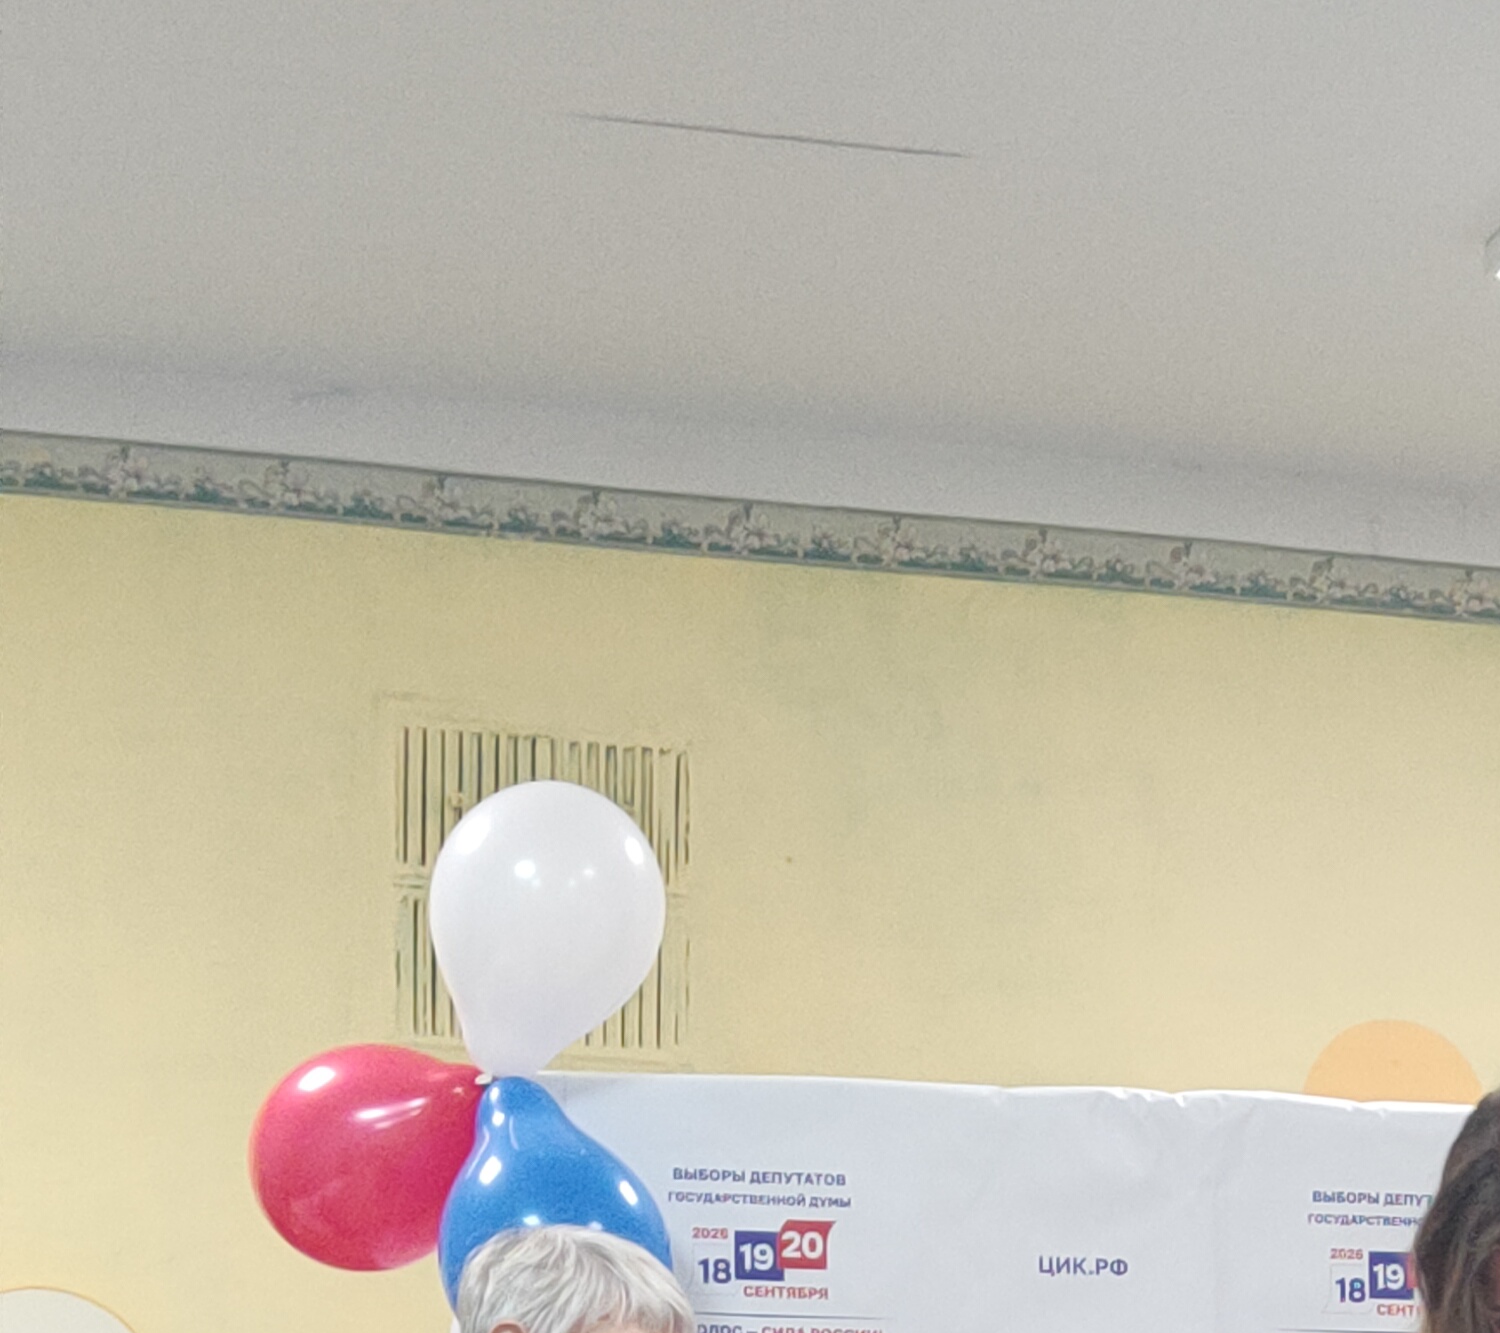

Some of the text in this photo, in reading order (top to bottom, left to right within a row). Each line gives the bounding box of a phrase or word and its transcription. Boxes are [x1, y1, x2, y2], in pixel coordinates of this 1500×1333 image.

[673, 1167, 846, 1187] ВЫБОРЫ ДЕПУТАТОВ
[668, 1191, 851, 1209] ГОСУДАРСТВЕННОЙ ДУМЫ
[1312, 1190, 1433, 1207] ВЫБОРЫ ДЕПУТ
[697, 1230, 823, 1285] 18 19 20
[1038, 1256, 1129, 1276] ЦИК.РФ
[1335, 1263, 1405, 1303] 18 19
[743, 1285, 829, 1301] СЕНТЯБРЯ
[1377, 1303, 1421, 1317] СЕНТ
